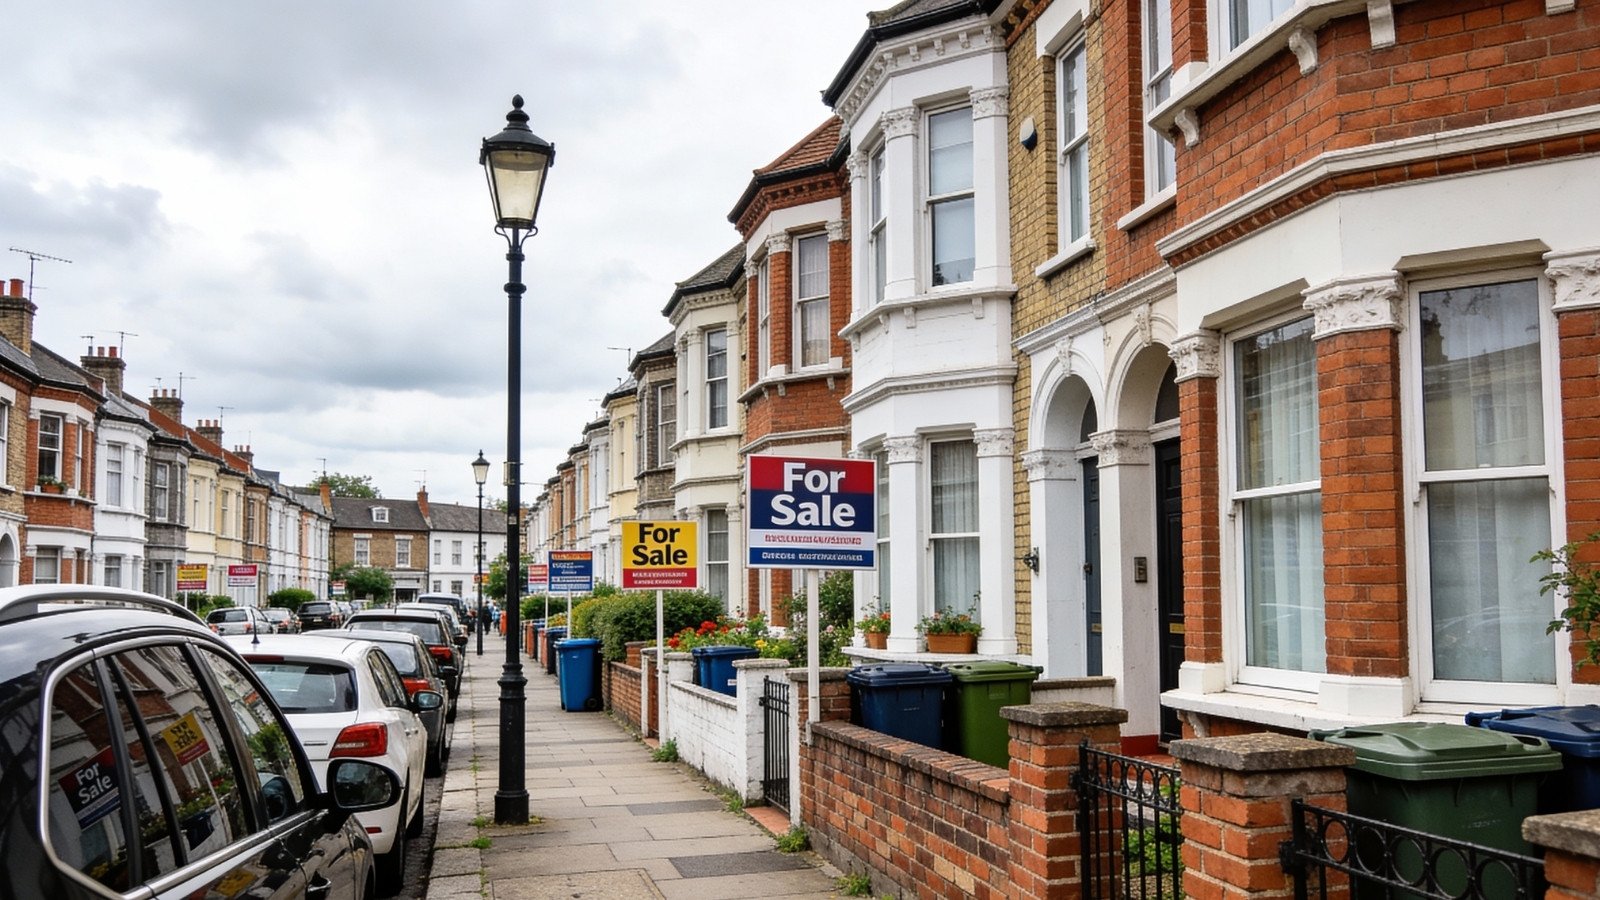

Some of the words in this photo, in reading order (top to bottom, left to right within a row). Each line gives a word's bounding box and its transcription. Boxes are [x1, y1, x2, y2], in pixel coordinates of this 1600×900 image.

[783, 462, 846, 493] For
[771, 494, 856, 527] Sale
[639, 523, 681, 543] For
[632, 544, 688, 566] Sale
[75, 762, 100, 787] For
[78, 776, 113, 805] Sale
